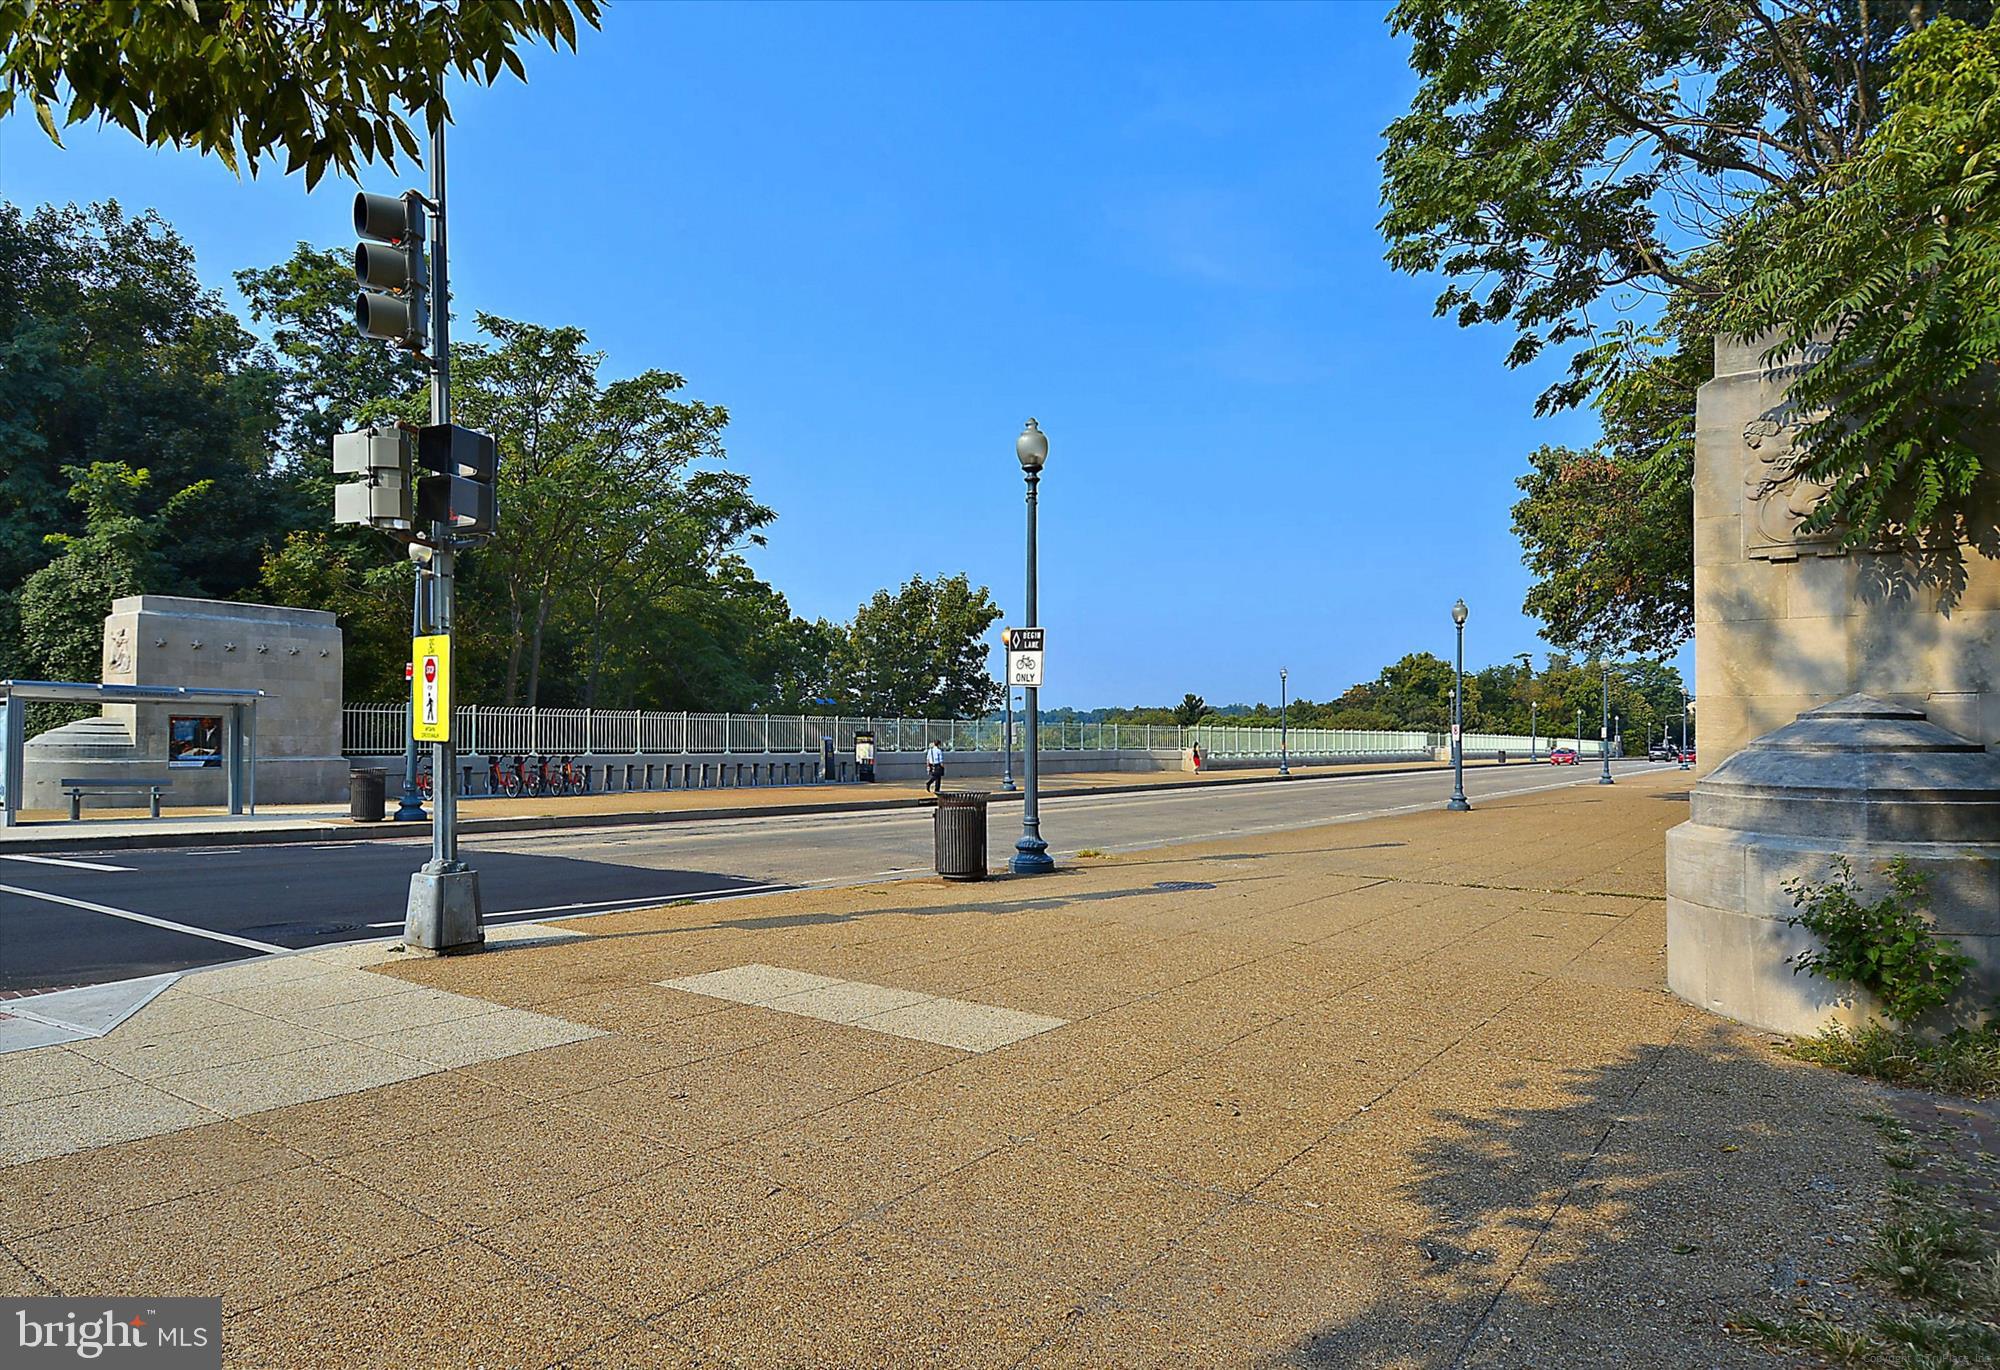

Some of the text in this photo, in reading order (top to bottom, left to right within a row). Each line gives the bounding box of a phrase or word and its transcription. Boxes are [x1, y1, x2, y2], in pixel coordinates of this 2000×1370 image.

[1023, 631, 1041, 640] BEGIN
[1024, 641, 1039, 649] LANE
[1016, 673, 1035, 682] ONLY
